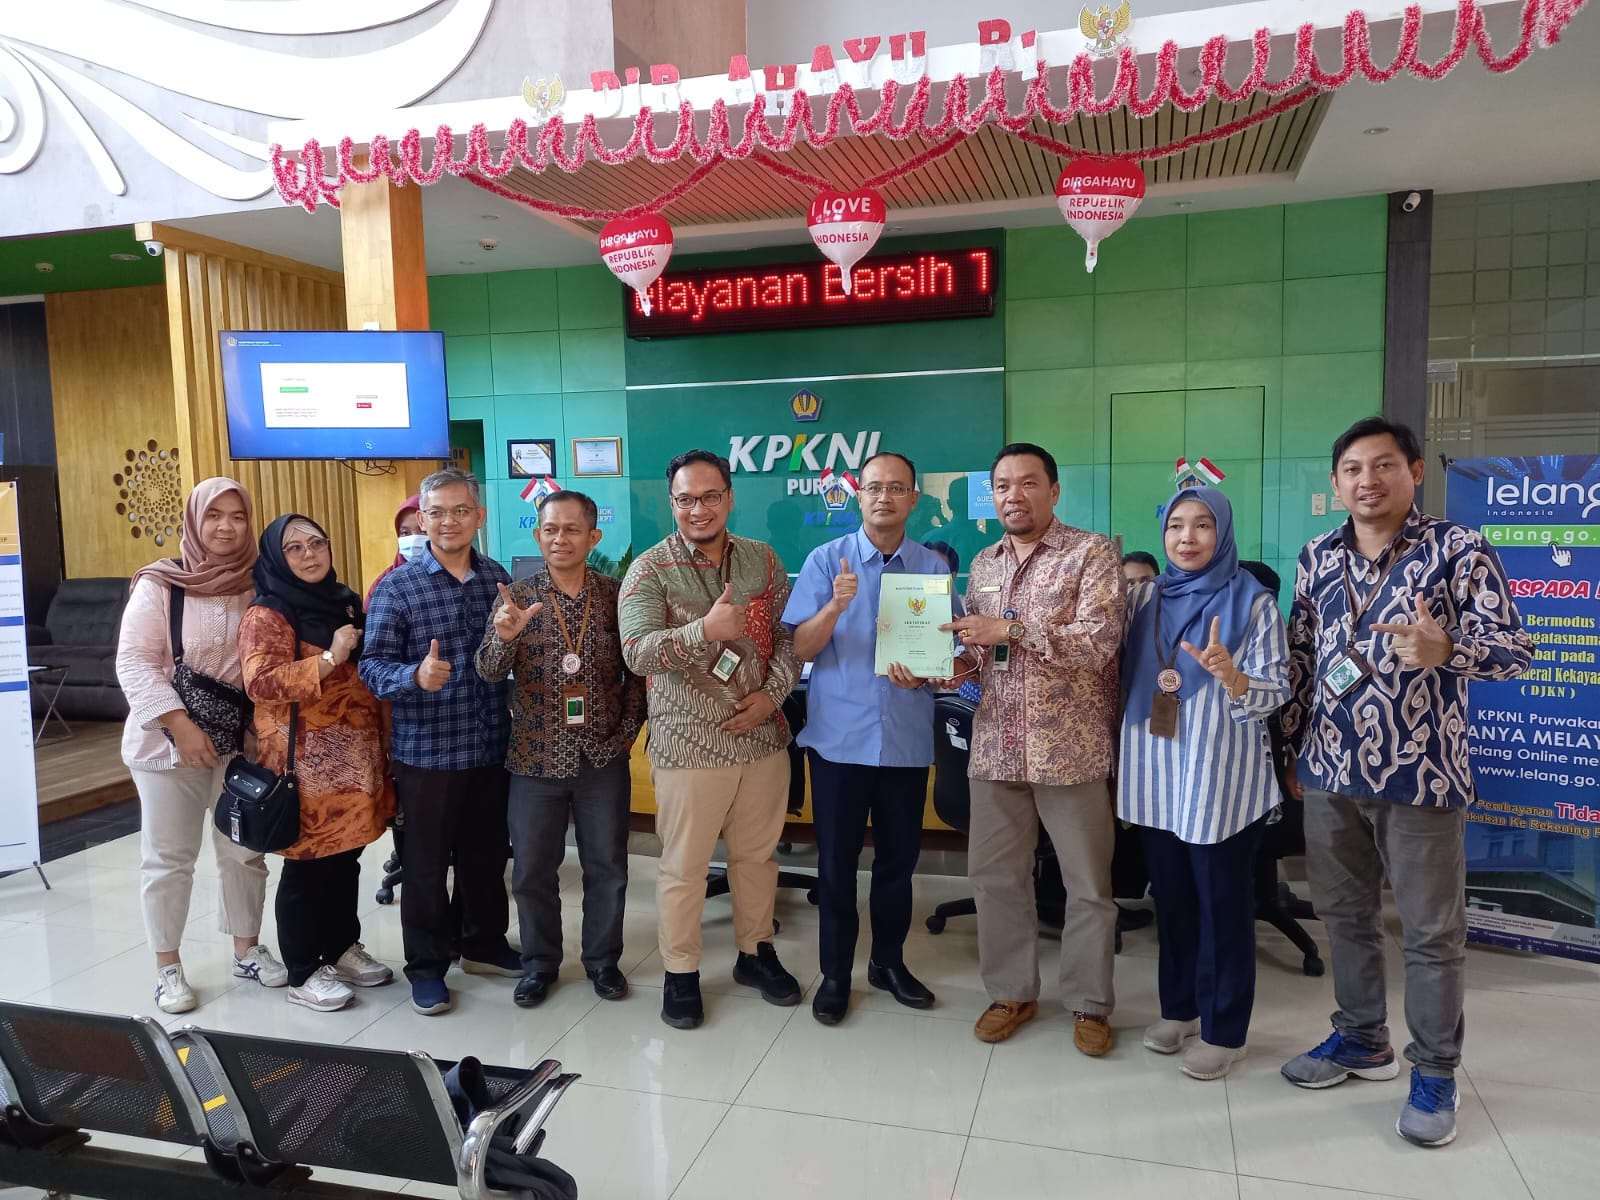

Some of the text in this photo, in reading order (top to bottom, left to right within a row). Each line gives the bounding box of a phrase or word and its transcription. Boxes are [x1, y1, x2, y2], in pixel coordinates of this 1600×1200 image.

[1062, 176, 1136, 189] DIRGAHAYU
[811, 197, 872, 217] I LOVE
[1069, 197, 1126, 208] REPUBLIK
[1067, 210, 1124, 221] INDONESIA
[600, 228, 658, 248] DIRGAHAYU
[815, 232, 869, 244] INDONESIA
[608, 247, 655, 264] REPUBLIK
[611, 260, 657, 274] INDONESIA
[824, 255, 954, 301] Bersih
[1487, 509, 1554, 517] Indonesia
[1526, 614, 1596, 629] Bermodus
[1560, 651, 1595, 663] pada
[1530, 685, 1566, 698] DJKN
[1478, 709, 1525, 723] KPKNL
[1517, 748, 1568, 764] Online
[1476, 799, 1554, 818] Pembayaran
[1509, 816, 1526, 828] Ke
[1529, 819, 1590, 838] Rekening
